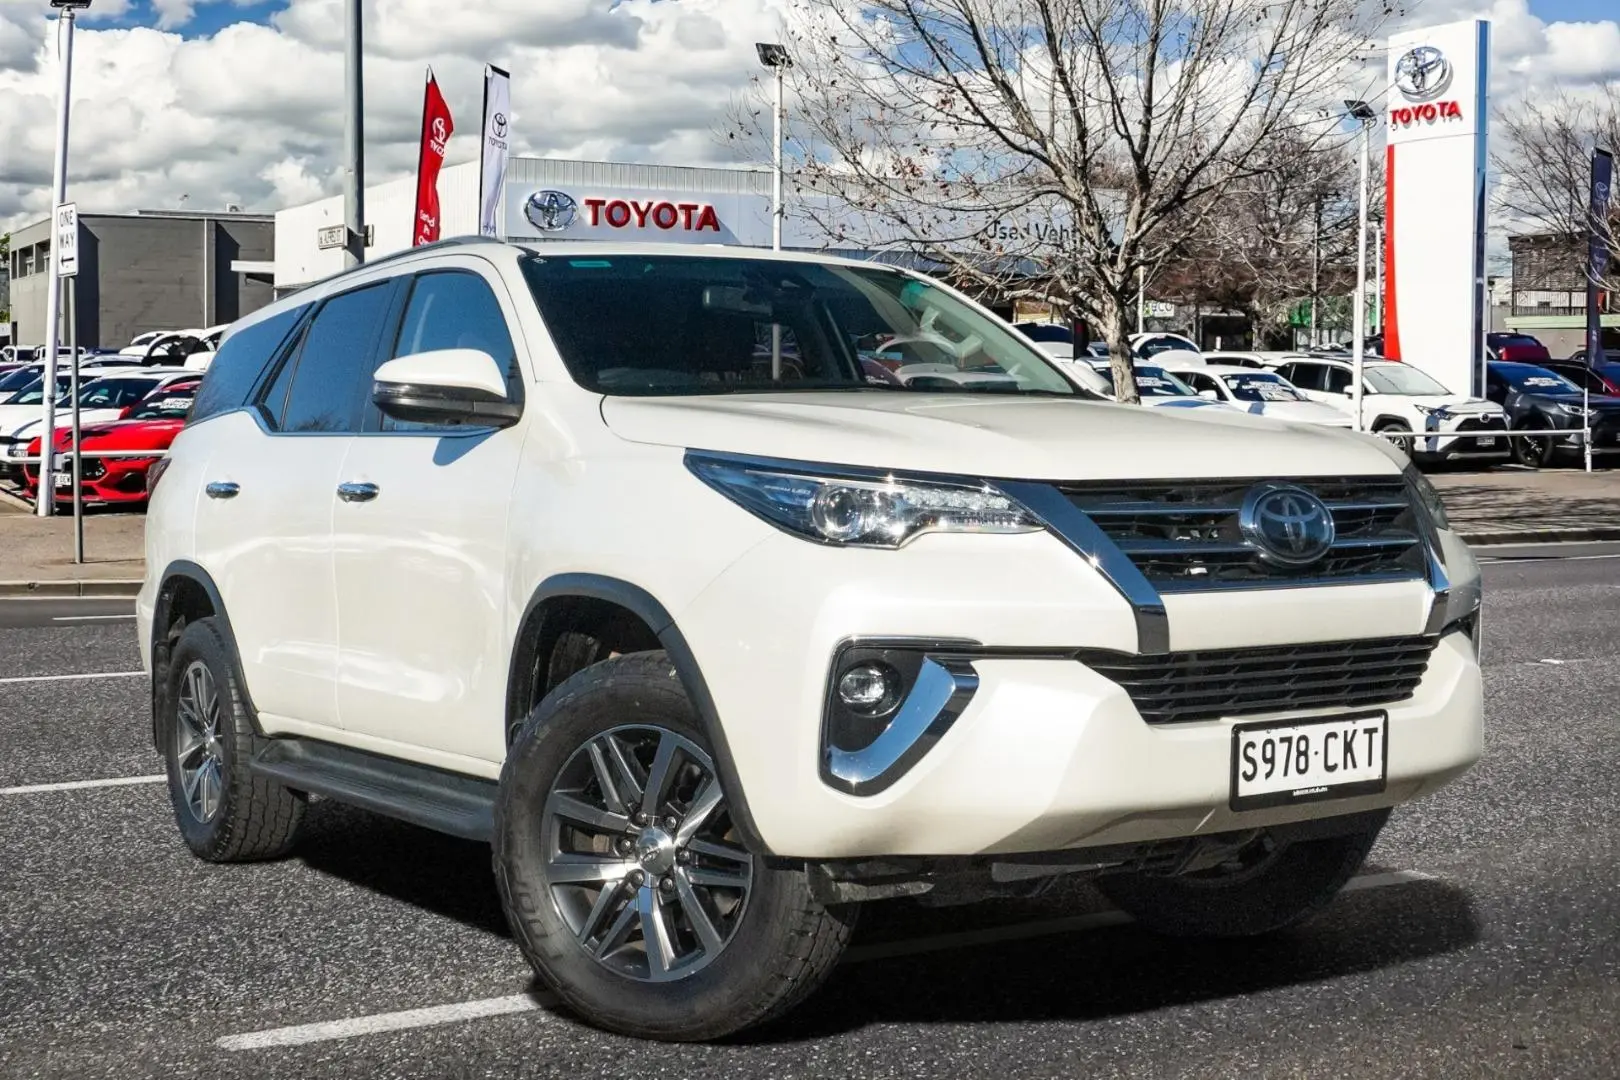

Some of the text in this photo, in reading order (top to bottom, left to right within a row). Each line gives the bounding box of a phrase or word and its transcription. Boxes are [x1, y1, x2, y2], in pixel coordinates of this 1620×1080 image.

[1390, 101, 1462, 124] TOYOTA
[60, 209, 73, 227] ONE
[585, 198, 721, 232] TOYOTA
[59, 232, 74, 248] WAY
[986, 219, 1031, 240] Used
